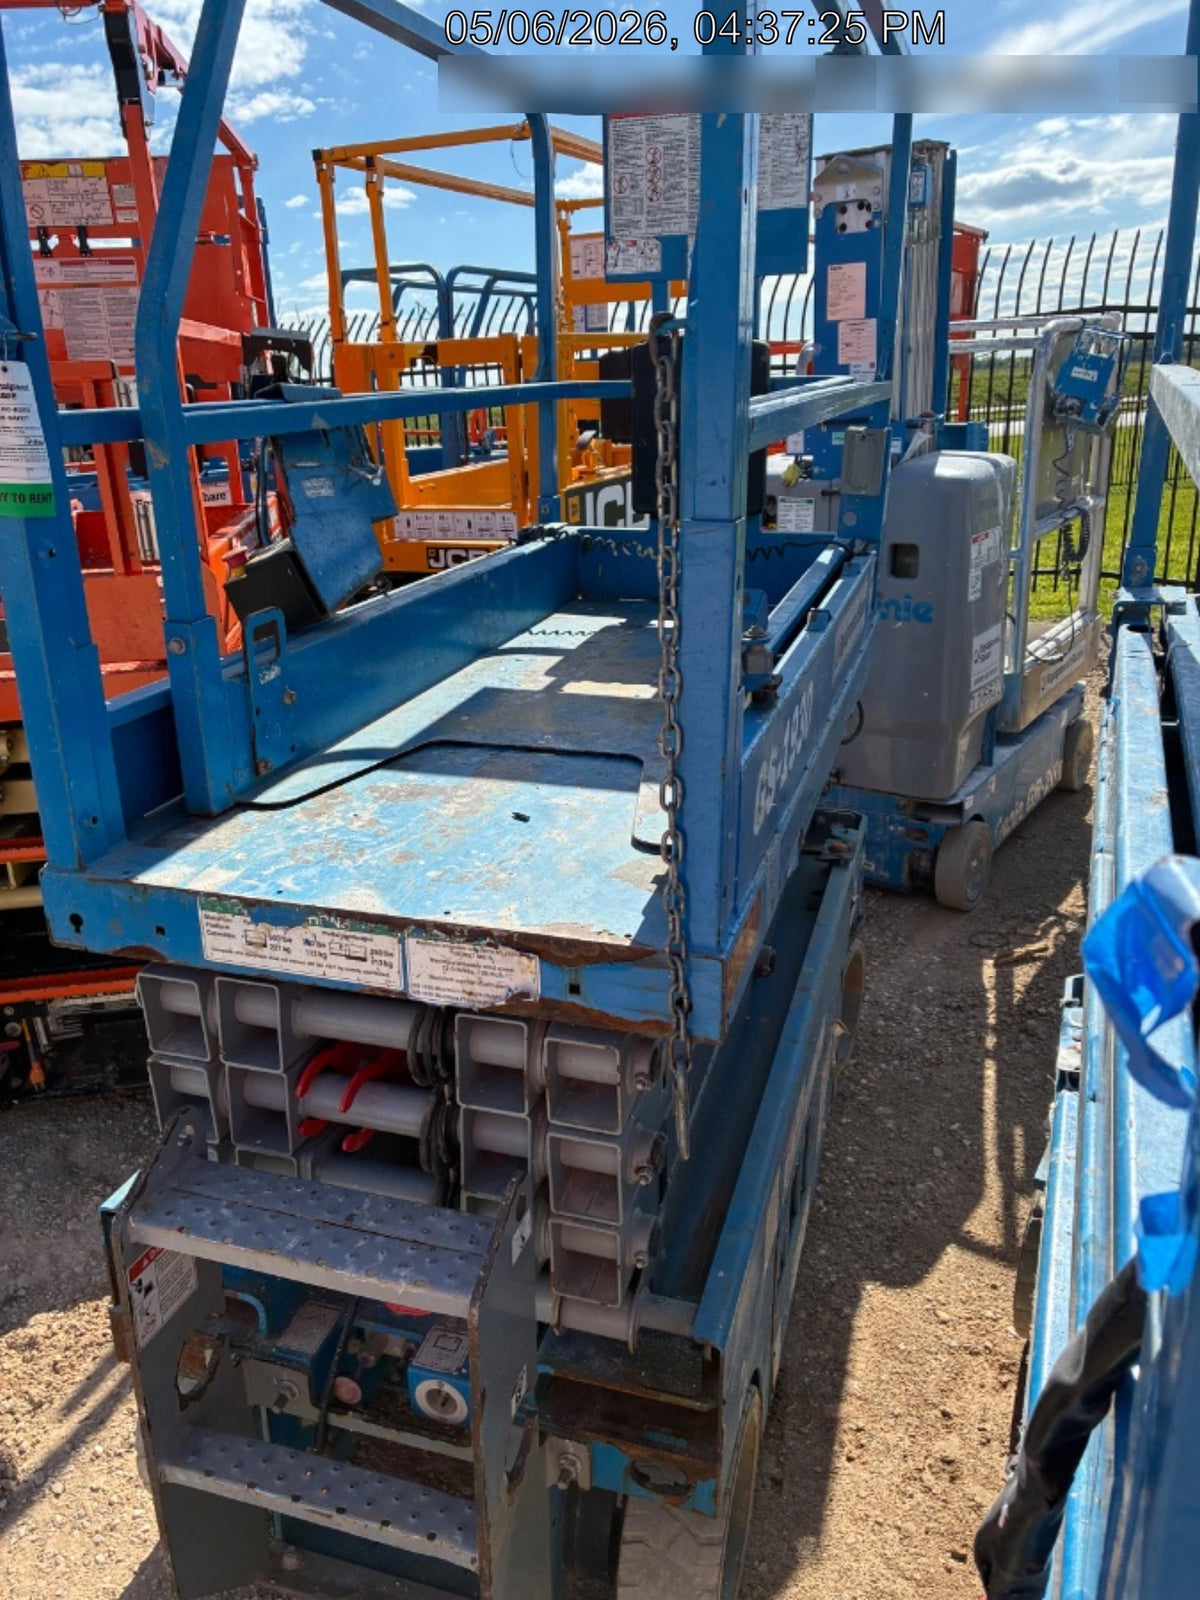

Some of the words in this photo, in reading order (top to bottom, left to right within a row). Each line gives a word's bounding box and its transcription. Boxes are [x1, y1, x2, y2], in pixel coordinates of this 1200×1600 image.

[11, 493, 26, 503] TO
[29, 492, 52, 504] RENT
[878, 593, 934, 623] nie
